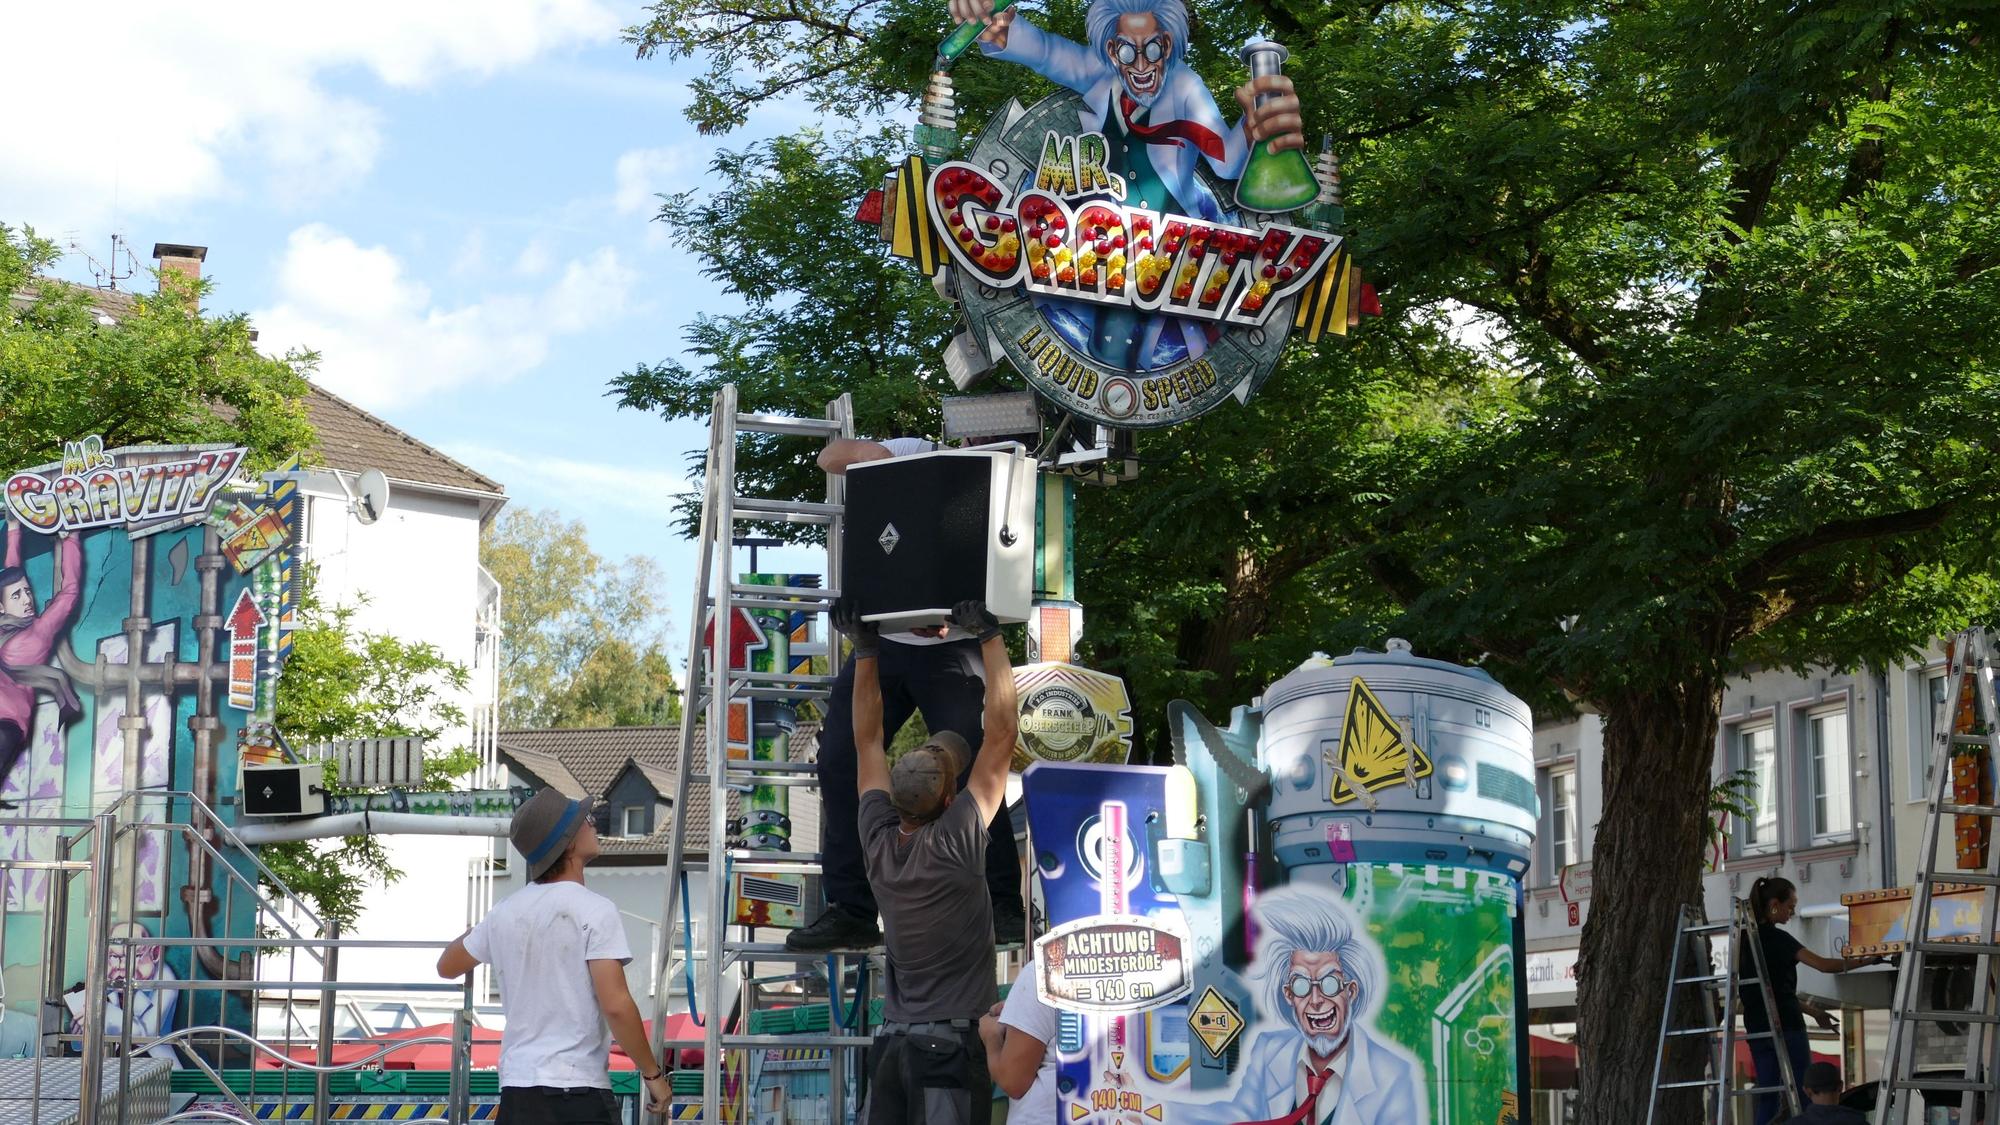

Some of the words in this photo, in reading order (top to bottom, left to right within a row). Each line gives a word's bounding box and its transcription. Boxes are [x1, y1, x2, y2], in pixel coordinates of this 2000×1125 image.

[1037, 132, 1126, 199] MR.
[930, 163, 1336, 322] GRAVITY
[1017, 324, 1099, 400] LIQUID
[1141, 358, 1217, 411] SPEED
[62, 435, 115, 476] MR.
[5, 449, 244, 532] GRAVITY
[1042, 708, 1073, 718] FRANK
[1046, 690, 1081, 706] INDUSTRIES
[1066, 929, 1156, 955] ACHTUNG!
[1096, 979, 1126, 1001] 140
[1129, 981, 1154, 1000] cm
[1091, 1088, 1117, 1112] 140
[1119, 1091, 1142, 1113] CM
